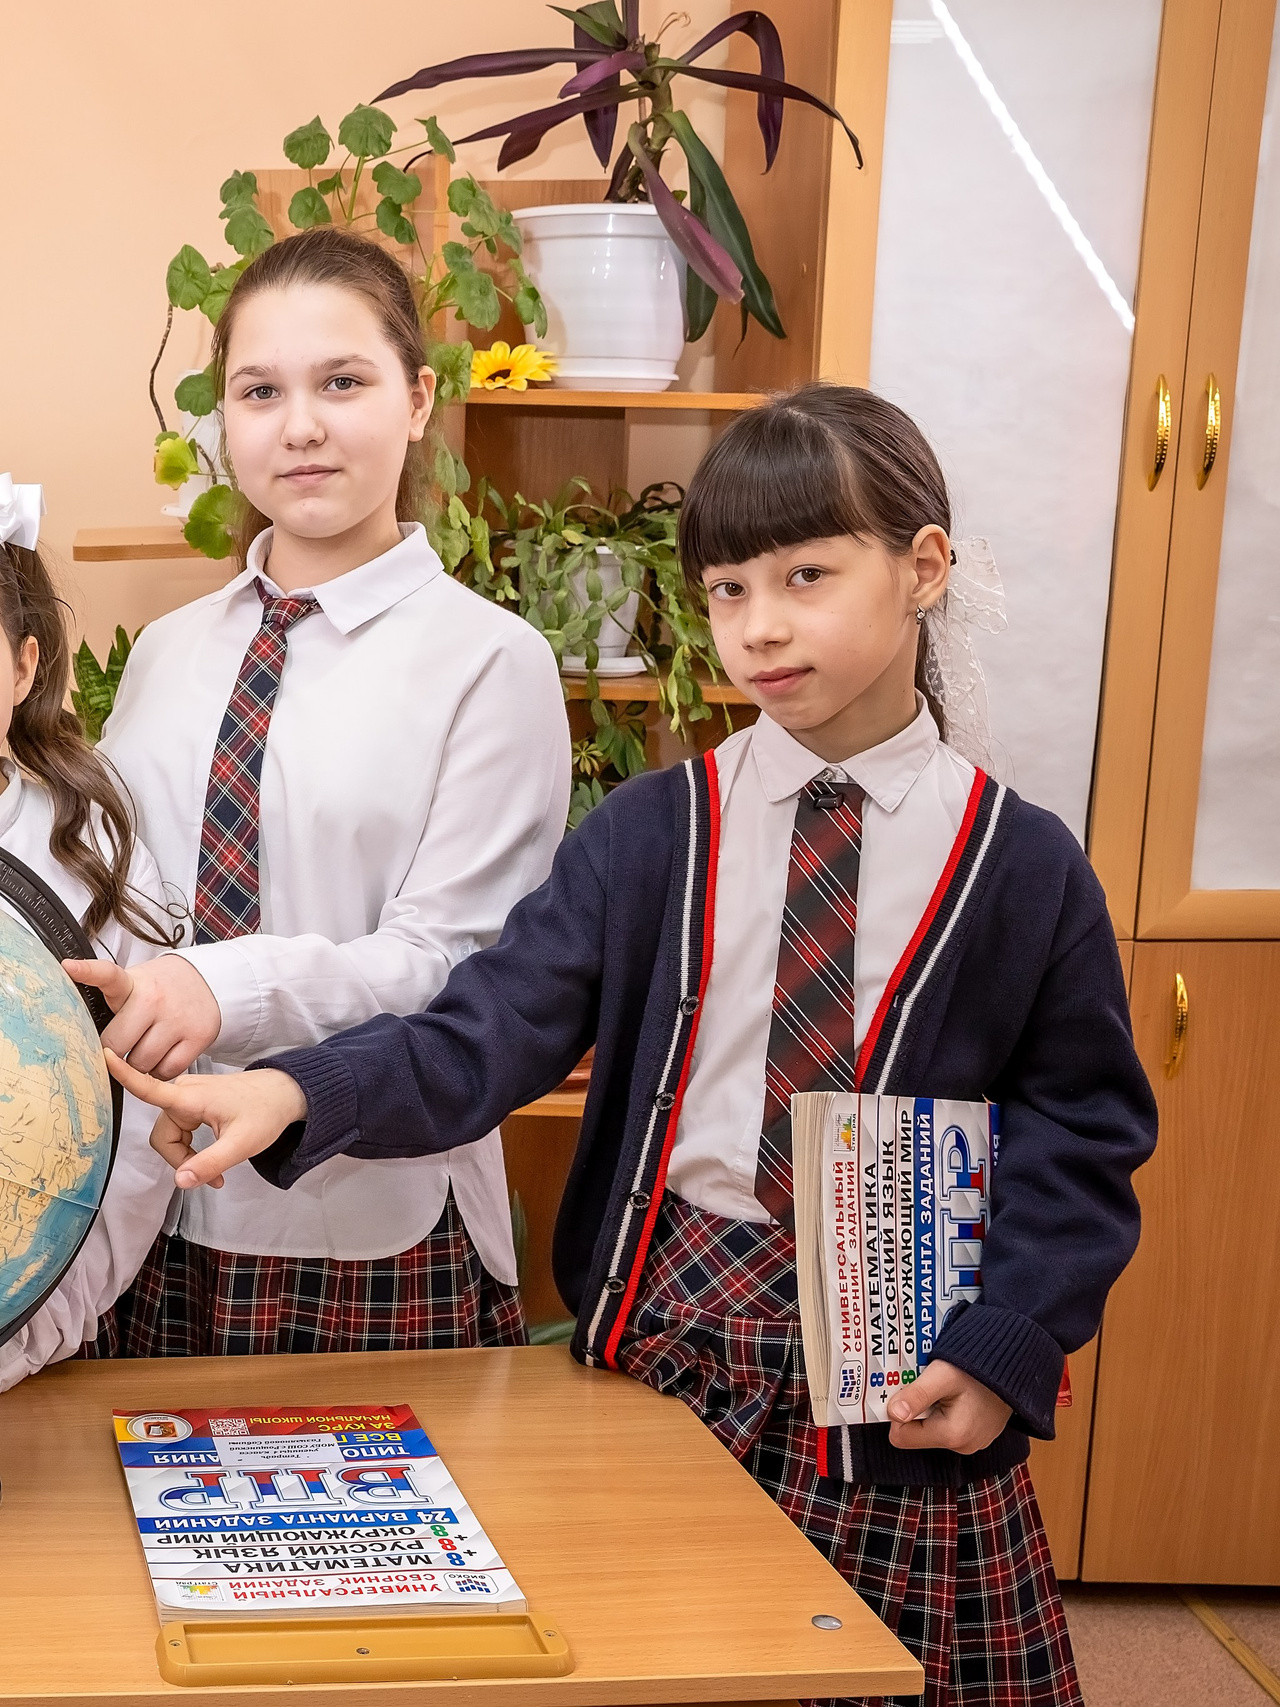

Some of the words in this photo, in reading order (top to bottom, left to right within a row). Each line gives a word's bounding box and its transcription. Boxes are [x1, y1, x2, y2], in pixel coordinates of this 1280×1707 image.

[901, 1110, 912, 1163] МИР
[916, 1114, 934, 1225] ЗАДАНИЙ
[882, 1140, 895, 1219] ЯЗЫК
[845, 1161, 857, 1249] ЗАДАНИЙ
[833, 1161, 852, 1353] УНИВЕРСАЛЬНЫЙ
[865, 1163, 882, 1356] МАТЕМАТИКА
[898, 1171, 915, 1355] ОКРУЖАЮЩИЙ
[880, 1229, 899, 1355] РУССКИЙ
[920, 1232, 933, 1354] ВАРИАНТА
[849, 1262, 862, 1352] СБОРНИК
[870, 1372, 885, 1387] 8
[887, 1370, 900, 1386] 8
[250, 1416, 303, 1424] ШКОЛЫ
[306, 1414, 391, 1424] НАЧАЛЬНОЙ
[369, 1422, 396, 1430] ЗА
[319, 1424, 364, 1432] КУРС
[356, 1433, 402, 1442] ВСЕ
[343, 1446, 410, 1458] ТИПО
[160, 1464, 434, 1512] ВПР
[154, 1515, 273, 1531] ЗАДАНИЙ
[279, 1511, 409, 1525] ВАРИАНТА
[417, 1510, 451, 1524] 24
[157, 1533, 213, 1544] МИР
[221, 1526, 415, 1545] ОКРУЖАЮЩИЙ
[430, 1525, 449, 1537] 8
[287, 1540, 424, 1559] РУССКИЙ
[438, 1538, 457, 1551] 8
[193, 1547, 280, 1559] ЯЗЫК
[446, 1552, 466, 1566] 8
[223, 1554, 433, 1574] МАТЕМАТИКА
[229, 1579, 326, 1591] ЗАДАНИЙ
[339, 1573, 436, 1585] СБОРНИК
[234, 1583, 442, 1601] УНИВЕРСАЛЬНЫЙ
